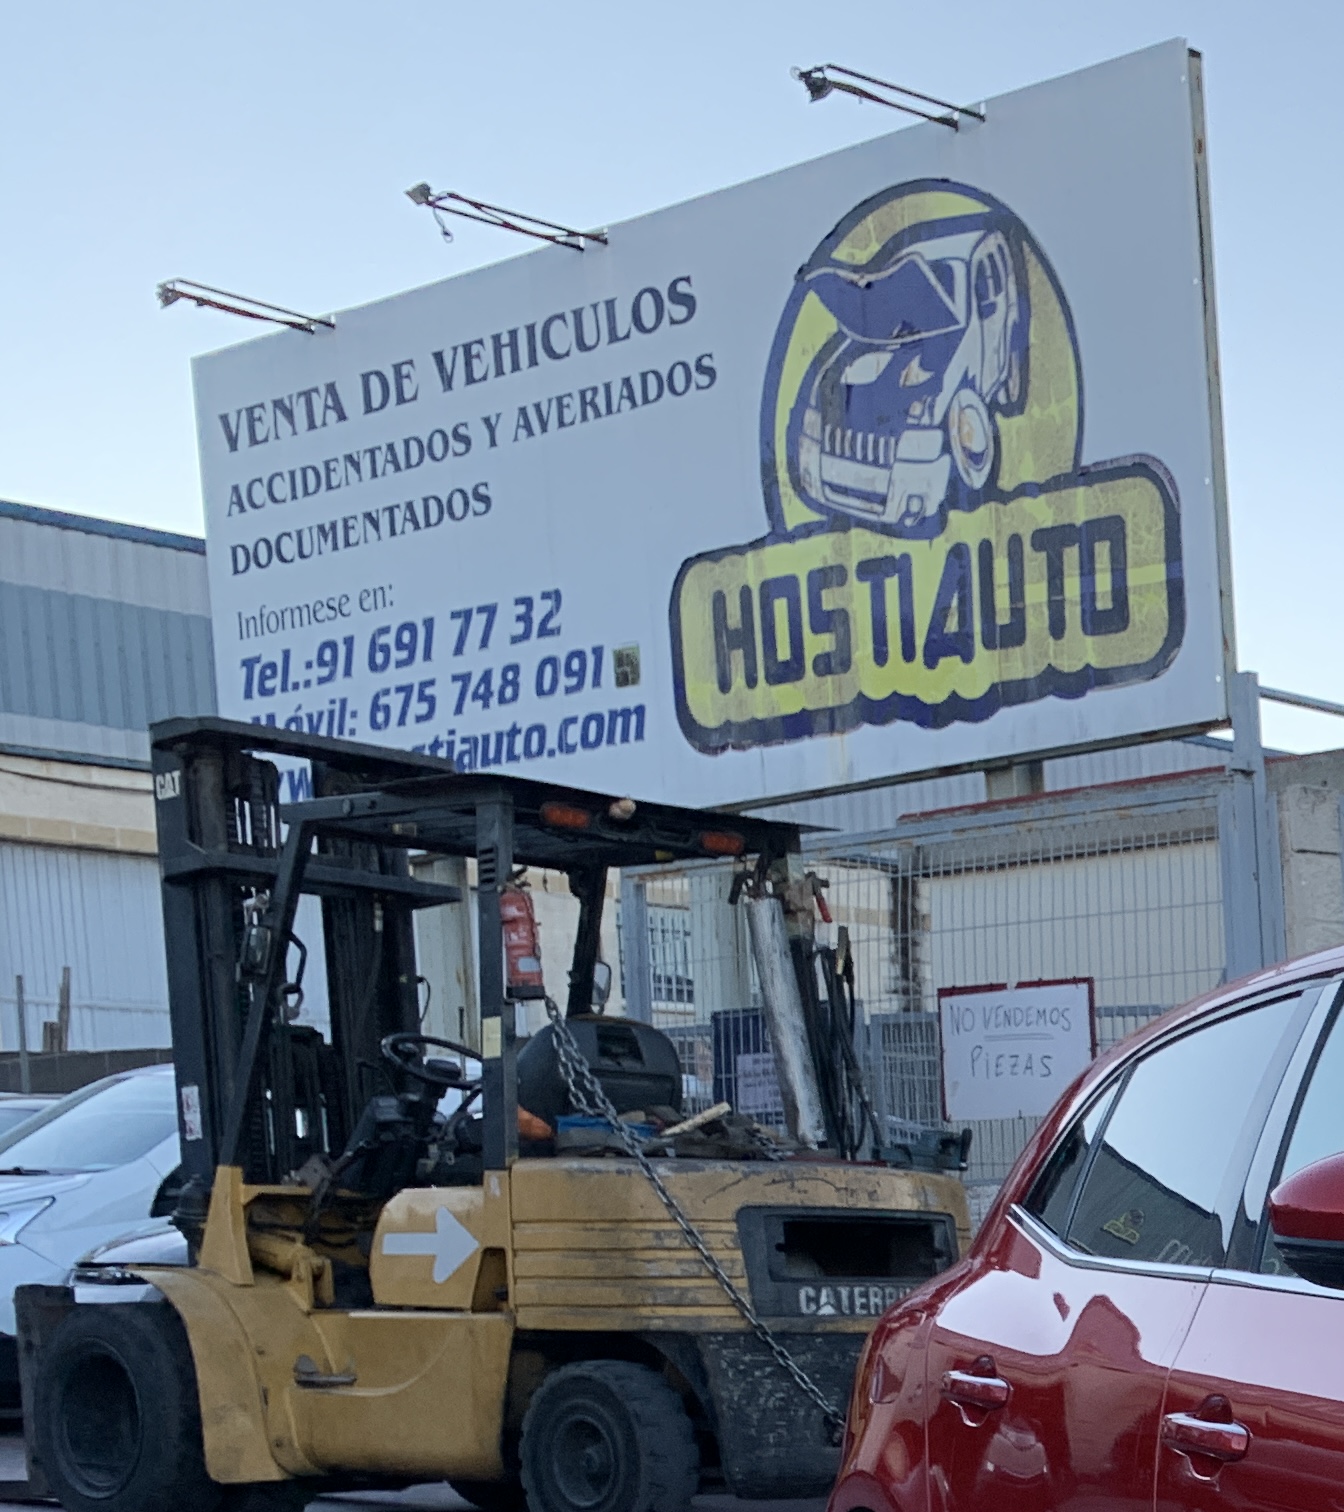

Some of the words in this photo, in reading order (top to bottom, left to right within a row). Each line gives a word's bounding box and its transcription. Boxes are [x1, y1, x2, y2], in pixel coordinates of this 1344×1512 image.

[218, 380, 348, 454] VENTA
[361, 359, 420, 416] DE
[431, 274, 699, 393] VEHICULOS
[226, 421, 473, 518] ACCIDENTADOS
[480, 412, 504, 449] Y
[512, 352, 718, 444] AVERIADOS
[229, 481, 493, 576] DOCUMENTADOS
[237, 590, 352, 640] Informese
[358, 583, 394, 613] en:
[367, 616, 435, 674] 691
[449, 602, 499, 657] 77
[509, 588, 563, 645] 32
[712, 514, 1130, 695] HOSTIAUTO
[369, 678, 438, 731] 675
[450, 662, 521, 716] 748
[535, 645, 605, 699] 091
[155, 770, 181, 800] CAT
[950, 1005, 975, 1036] NO
[983, 1005, 1072, 1032] VENDEMOS
[799, 1286, 911, 1315] CATERP
